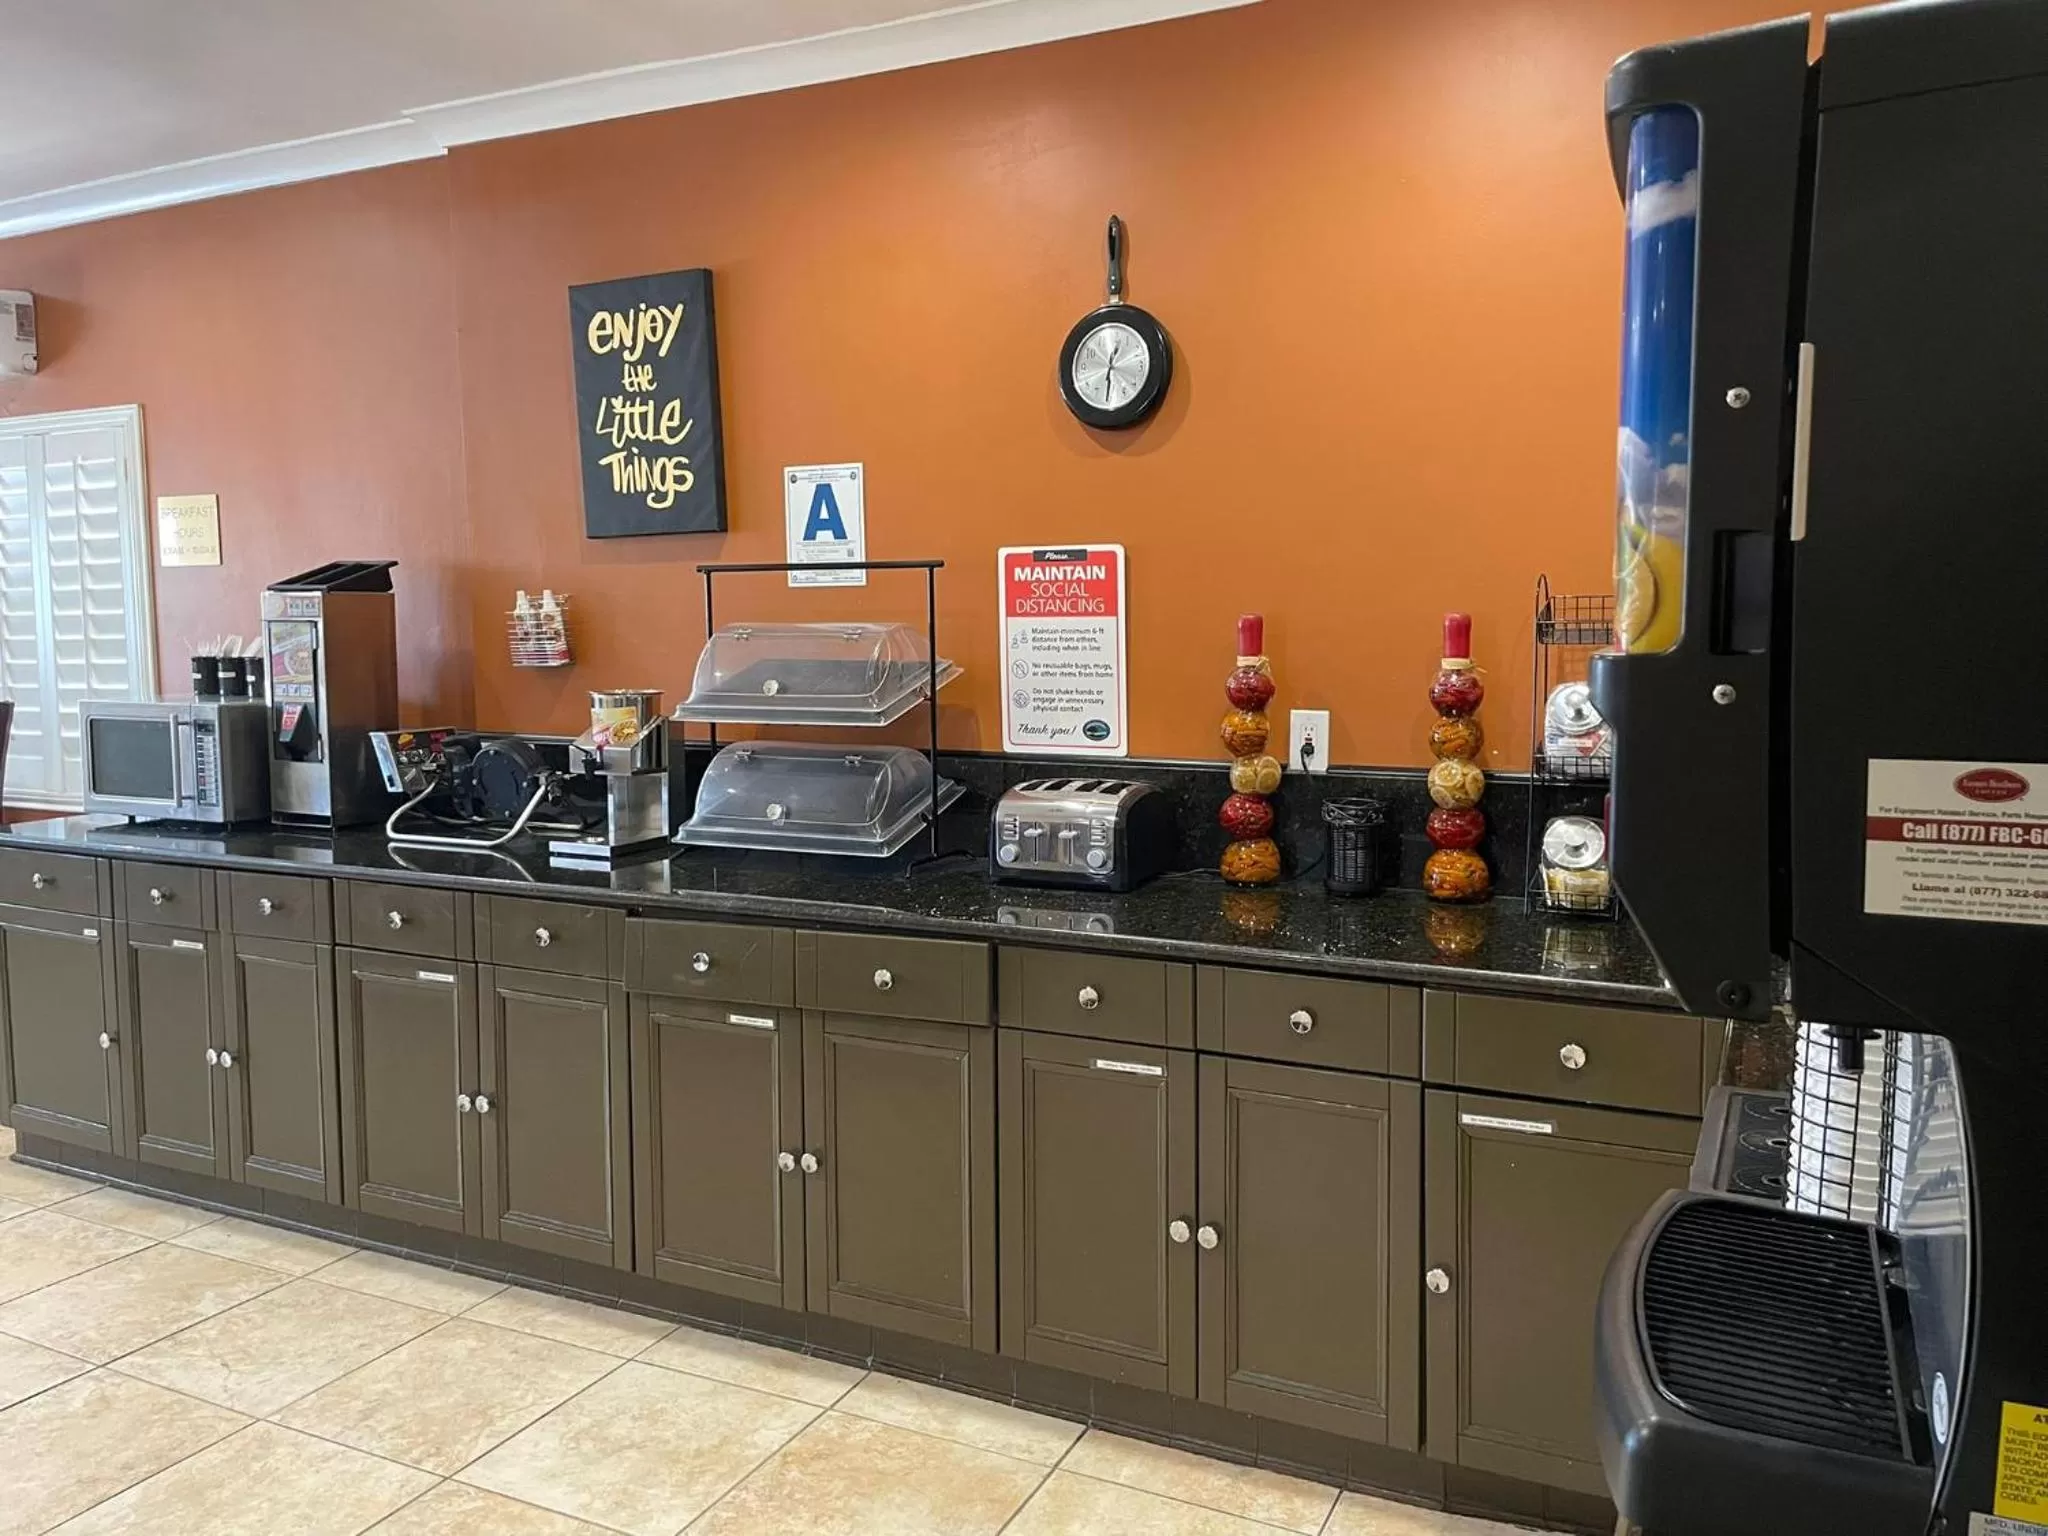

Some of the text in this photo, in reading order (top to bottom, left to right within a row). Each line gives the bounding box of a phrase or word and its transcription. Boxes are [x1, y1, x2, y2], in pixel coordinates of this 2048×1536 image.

[802, 483, 848, 541] A
[1014, 565, 1106, 581] MAINTAIN
[1031, 582, 1090, 597] SOCIAL
[1016, 598, 1105, 613] DISTANCING
[1031, 627, 1059, 635] Maintain
[1031, 644, 1060, 653] including
[1033, 705, 1058, 713] physical
[1017, 723, 1077, 739] Thank you!
[1902, 822, 1938, 840] Call
[1941, 823, 1985, 842] (877)
[1912, 883, 1949, 893] Llame
[1954, 885, 1966, 893] al
[1969, 886, 2002, 898] (877)
